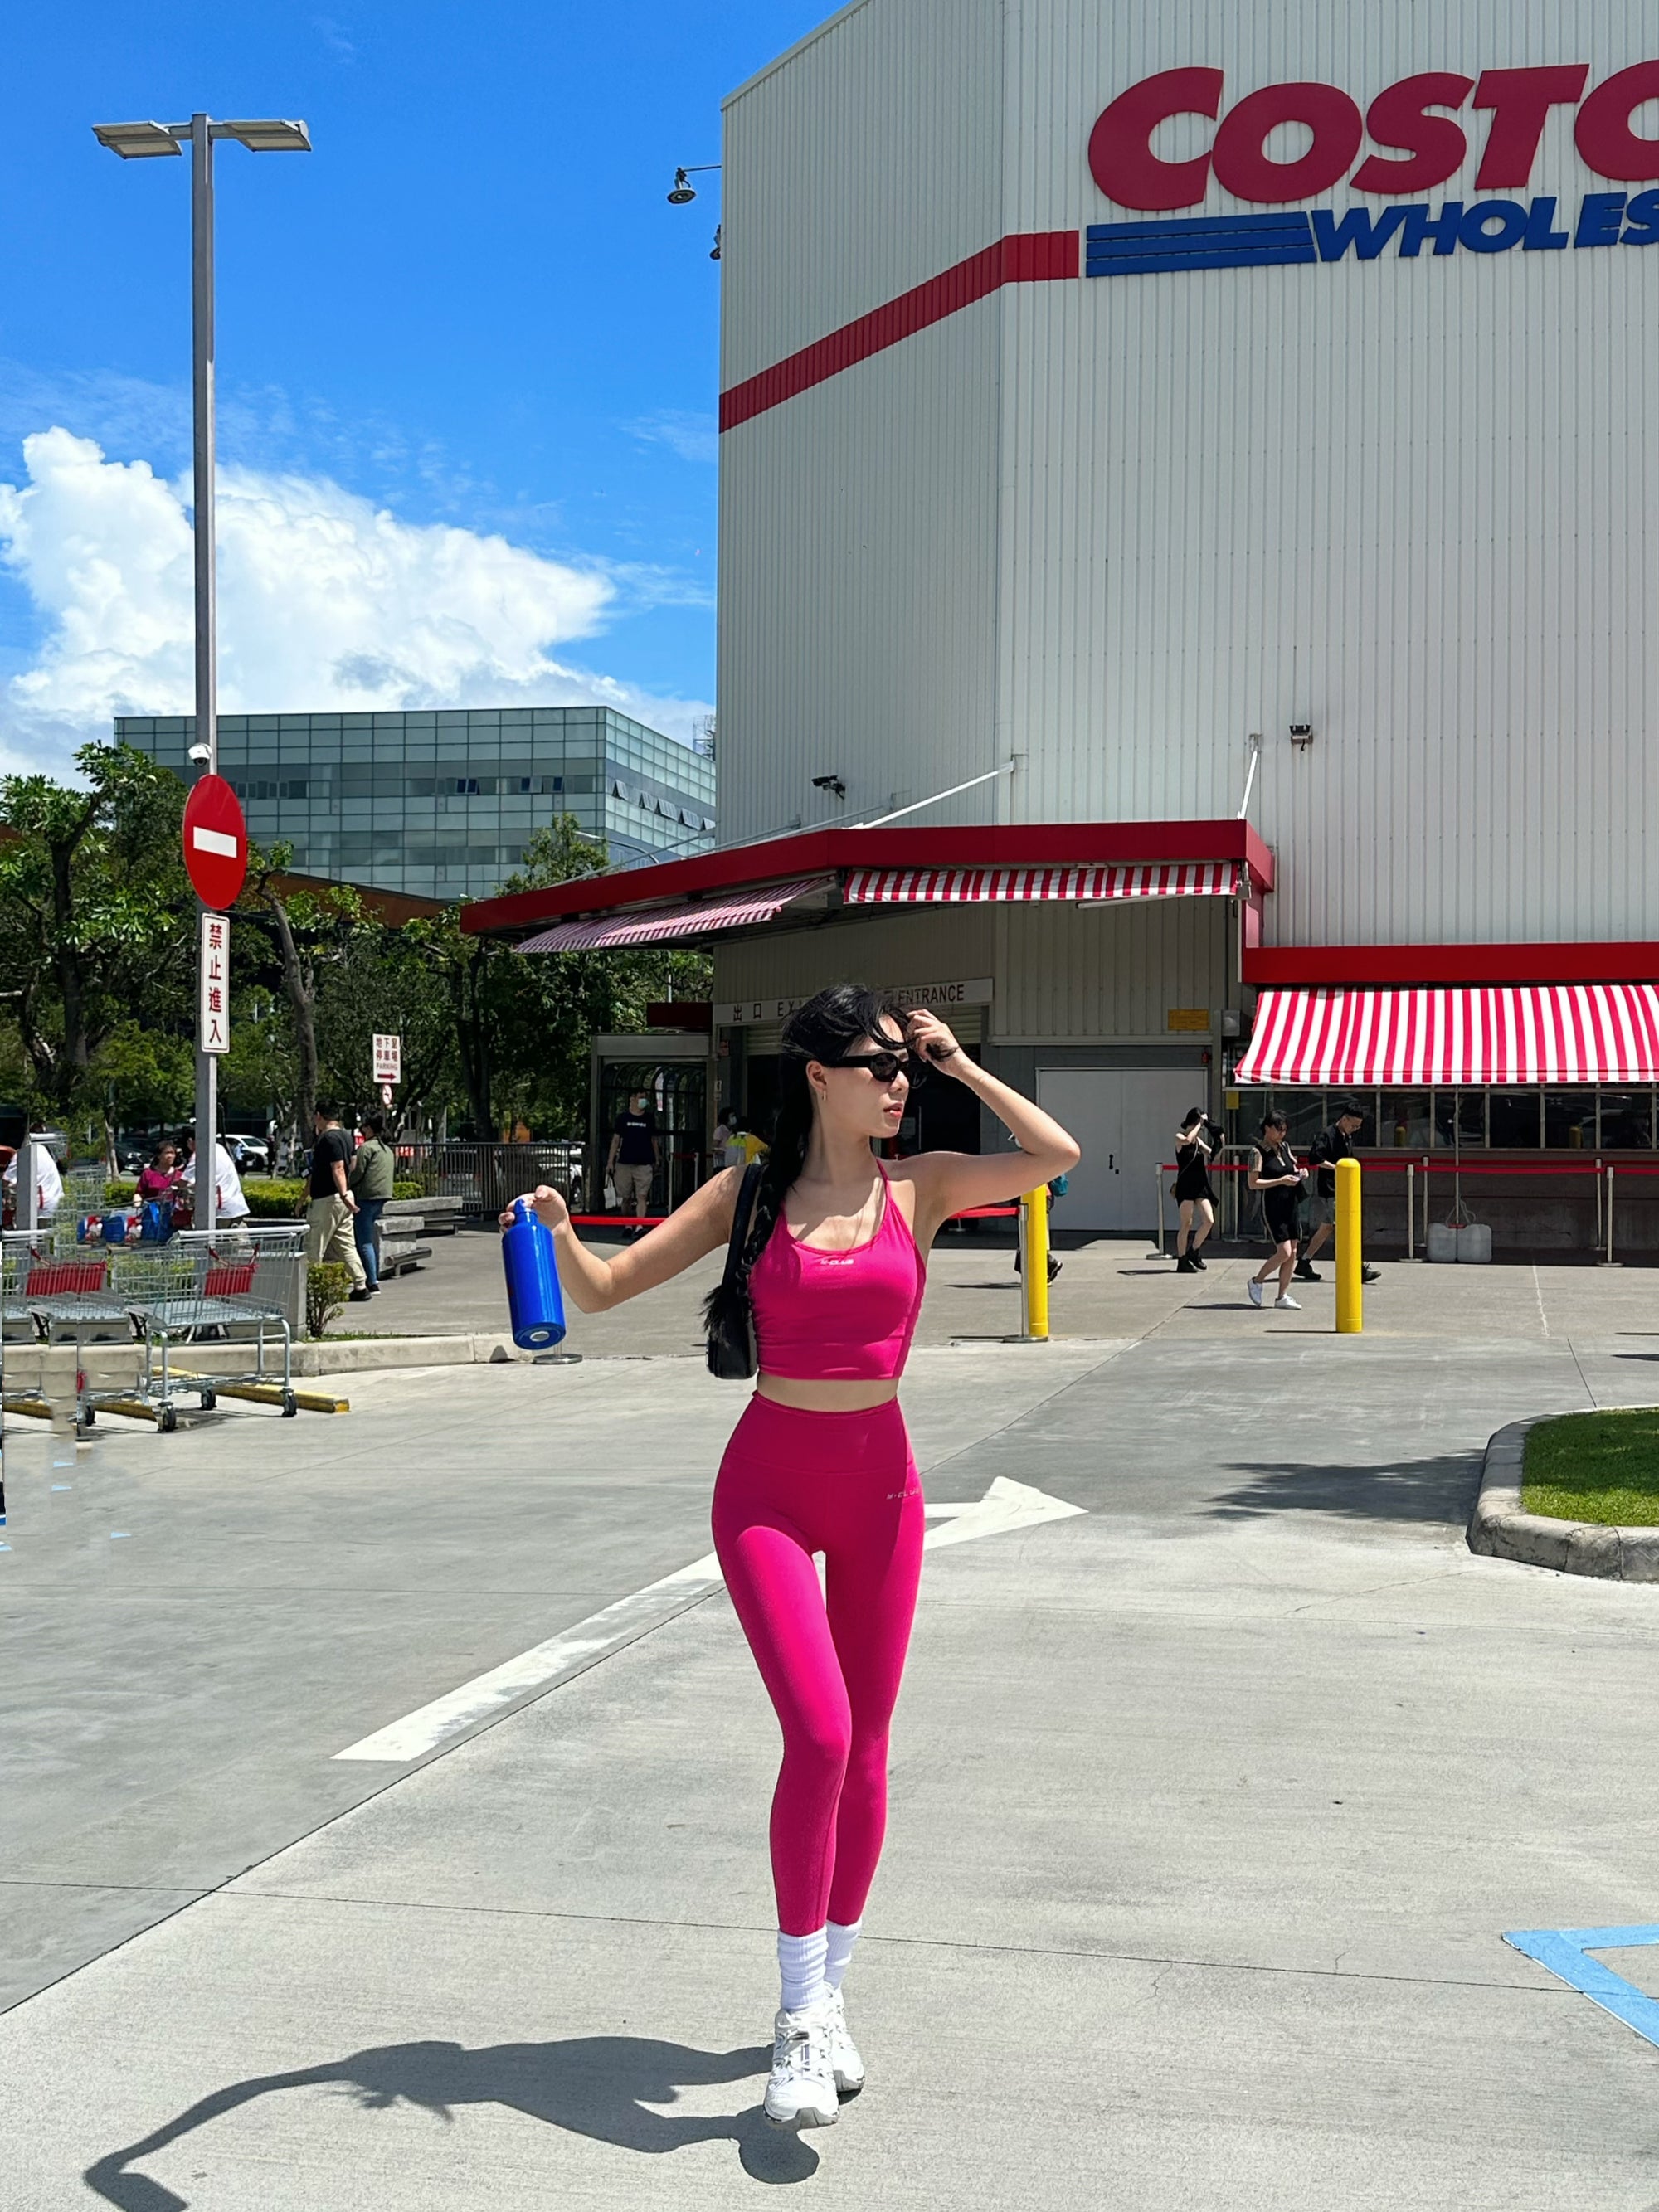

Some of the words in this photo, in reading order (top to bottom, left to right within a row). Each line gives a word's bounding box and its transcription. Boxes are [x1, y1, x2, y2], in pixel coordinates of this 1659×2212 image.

[1311, 189, 1659, 262] WHOLES
[209, 923, 222, 1043] 禁止進入
[733, 1003, 762, 1022] 出口
[898, 984, 965, 1005] ENTRANCE
